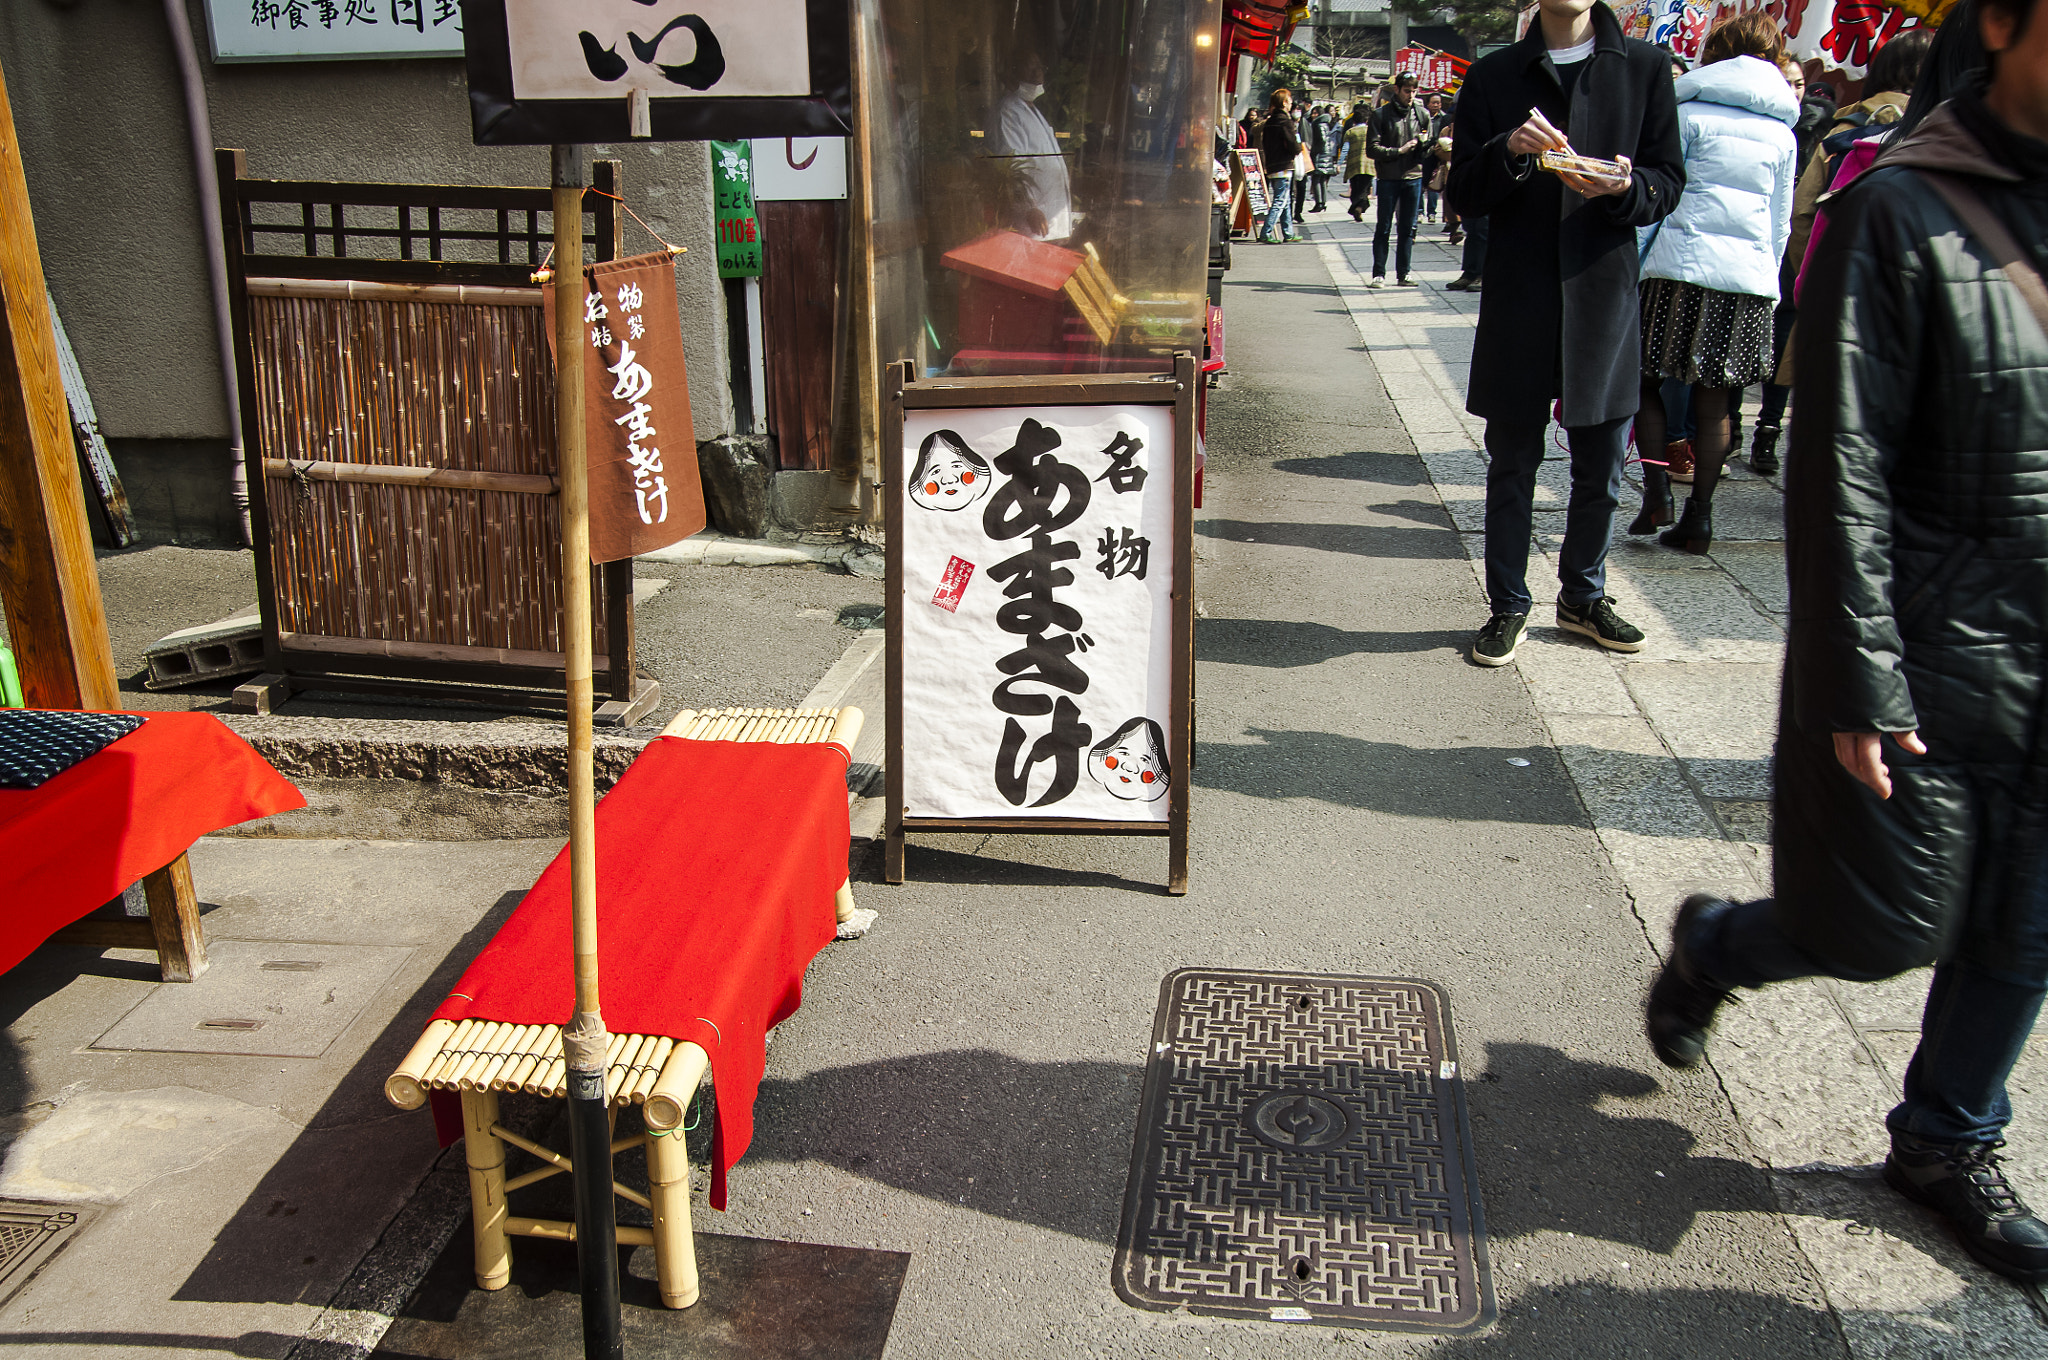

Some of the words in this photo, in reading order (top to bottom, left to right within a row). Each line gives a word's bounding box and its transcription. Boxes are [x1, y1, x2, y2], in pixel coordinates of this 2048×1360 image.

[719, 191, 752, 210] こども
[718, 217, 757, 243] 110番
[723, 252, 757, 270] のいえ
[1093, 430, 1150, 581] 名物
[982, 417, 1095, 808] あまざけ
